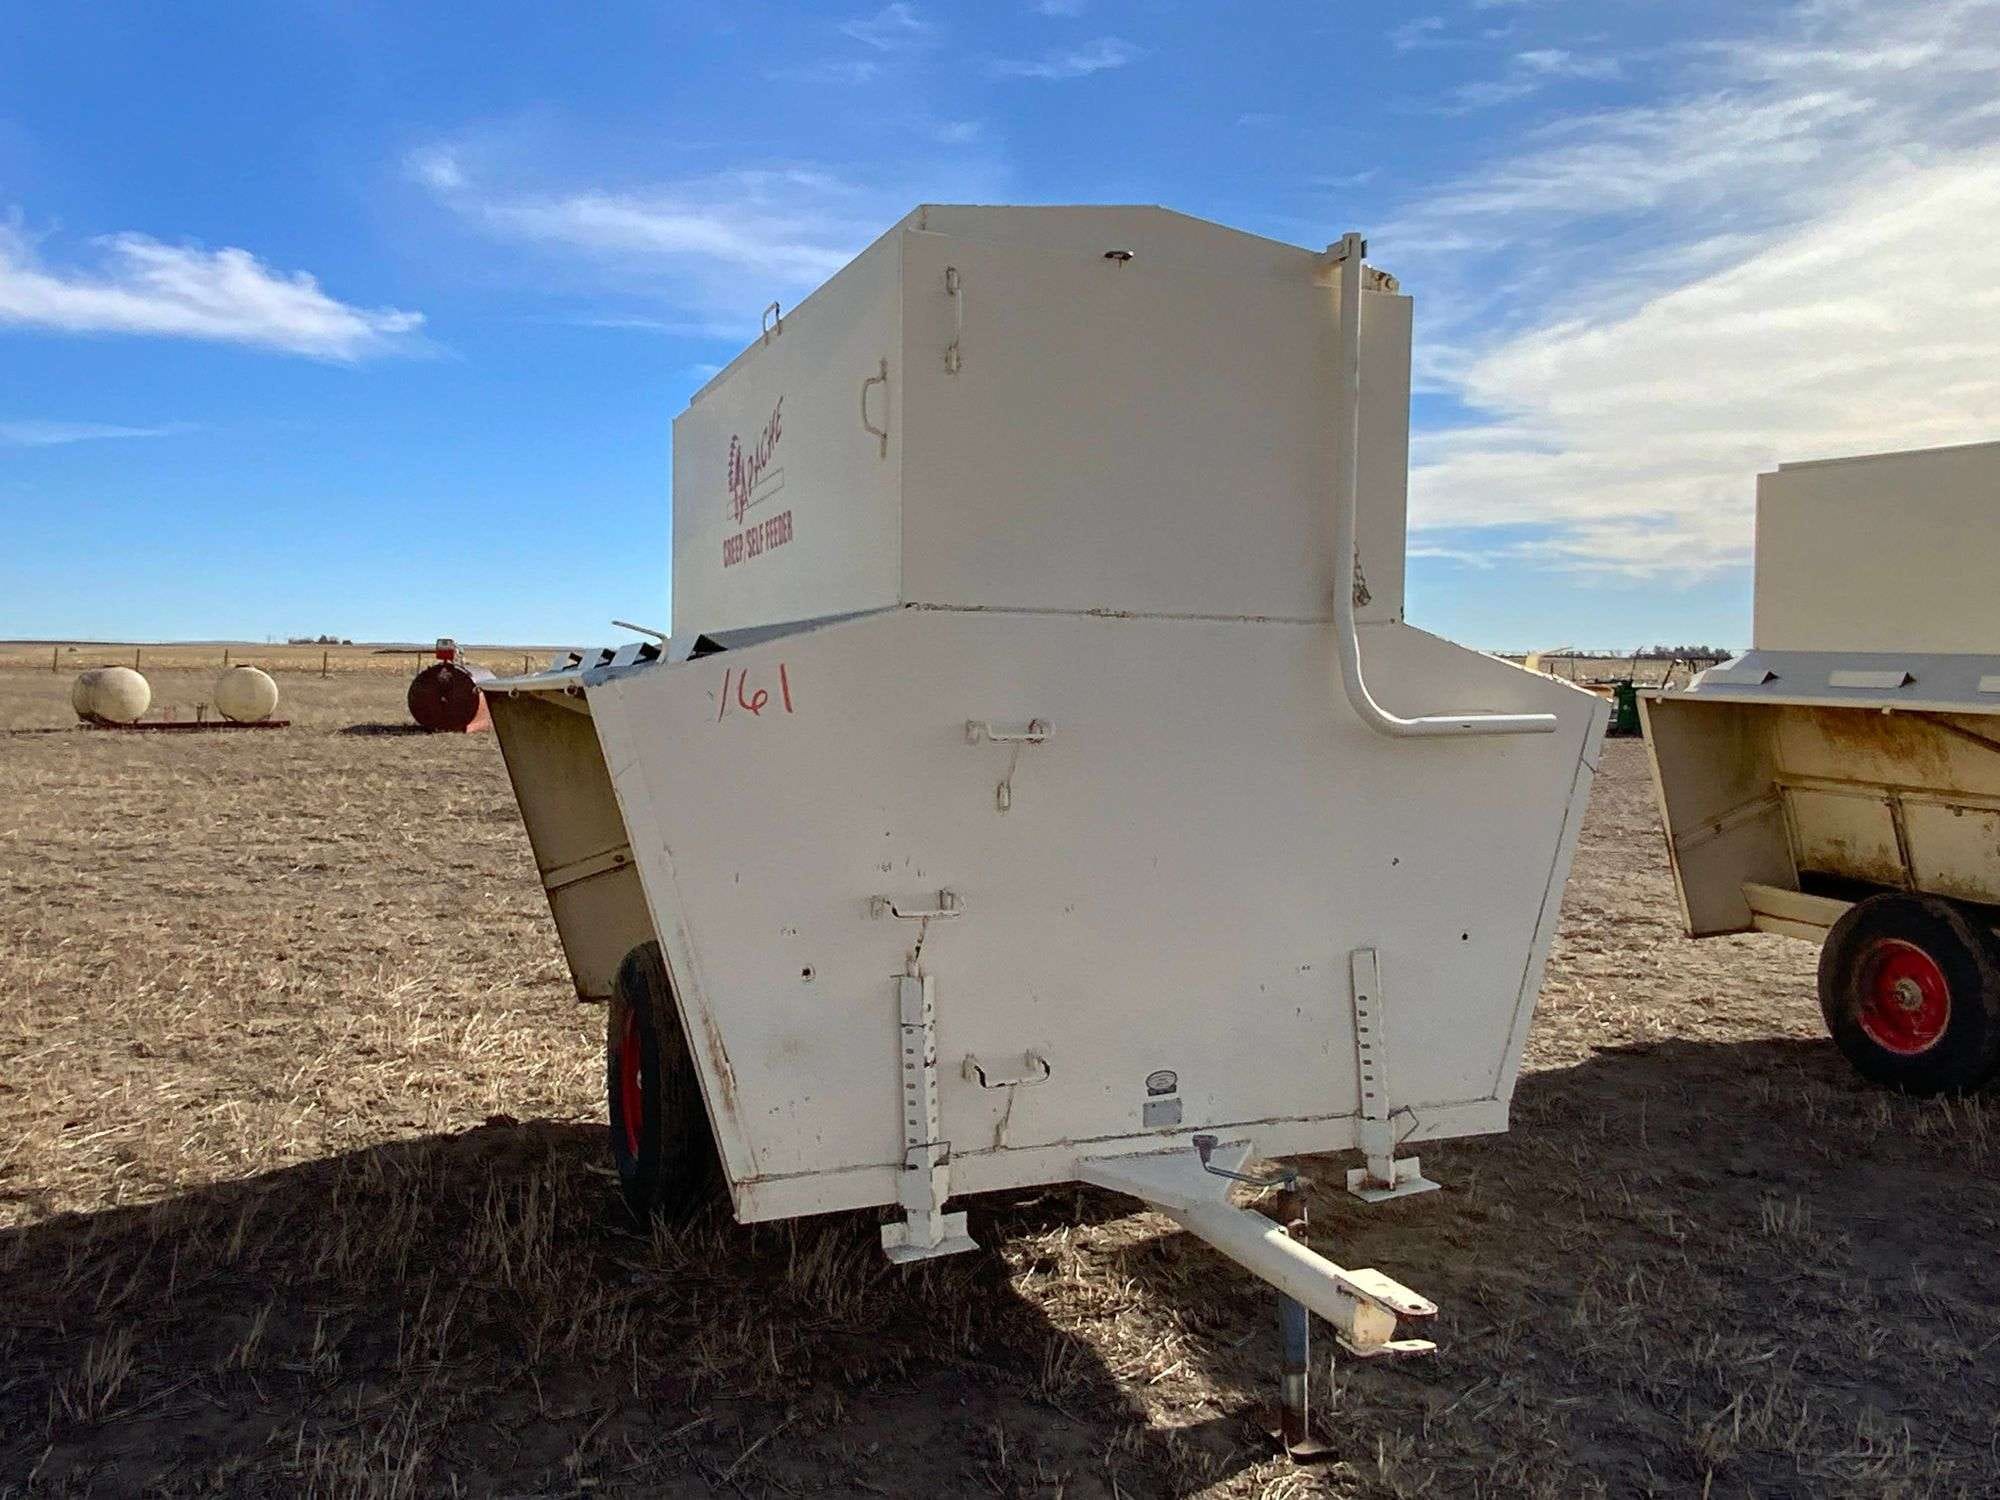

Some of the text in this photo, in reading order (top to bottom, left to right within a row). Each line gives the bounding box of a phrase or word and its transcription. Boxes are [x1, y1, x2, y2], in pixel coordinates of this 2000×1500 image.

[723, 510, 793, 568] CREEP SELF FEEDER
[718, 663, 793, 722] 161
